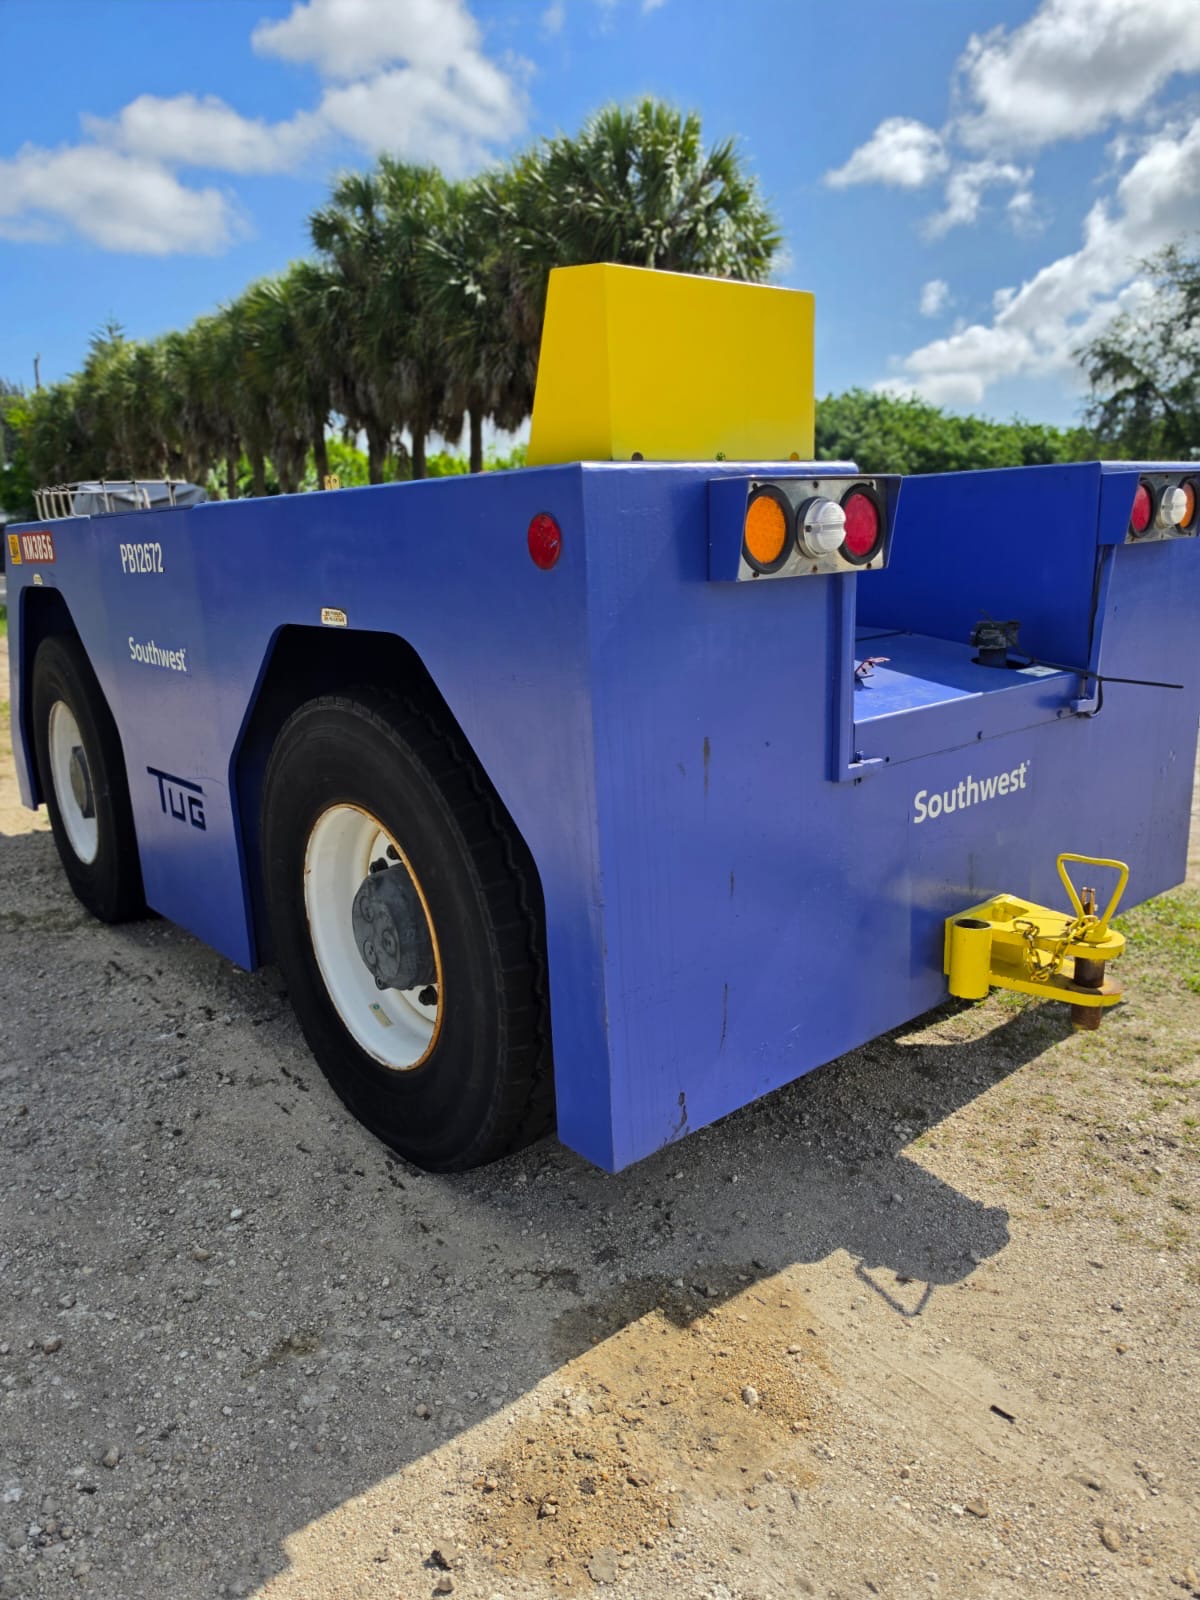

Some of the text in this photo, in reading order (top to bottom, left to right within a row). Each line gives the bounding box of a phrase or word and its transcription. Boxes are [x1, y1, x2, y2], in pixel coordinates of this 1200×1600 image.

[120, 542, 164, 574] PB12672
[128, 636, 187, 672] Southwest
[146, 766, 207, 831] TUG
[913, 760, 1029, 824] Southwest
